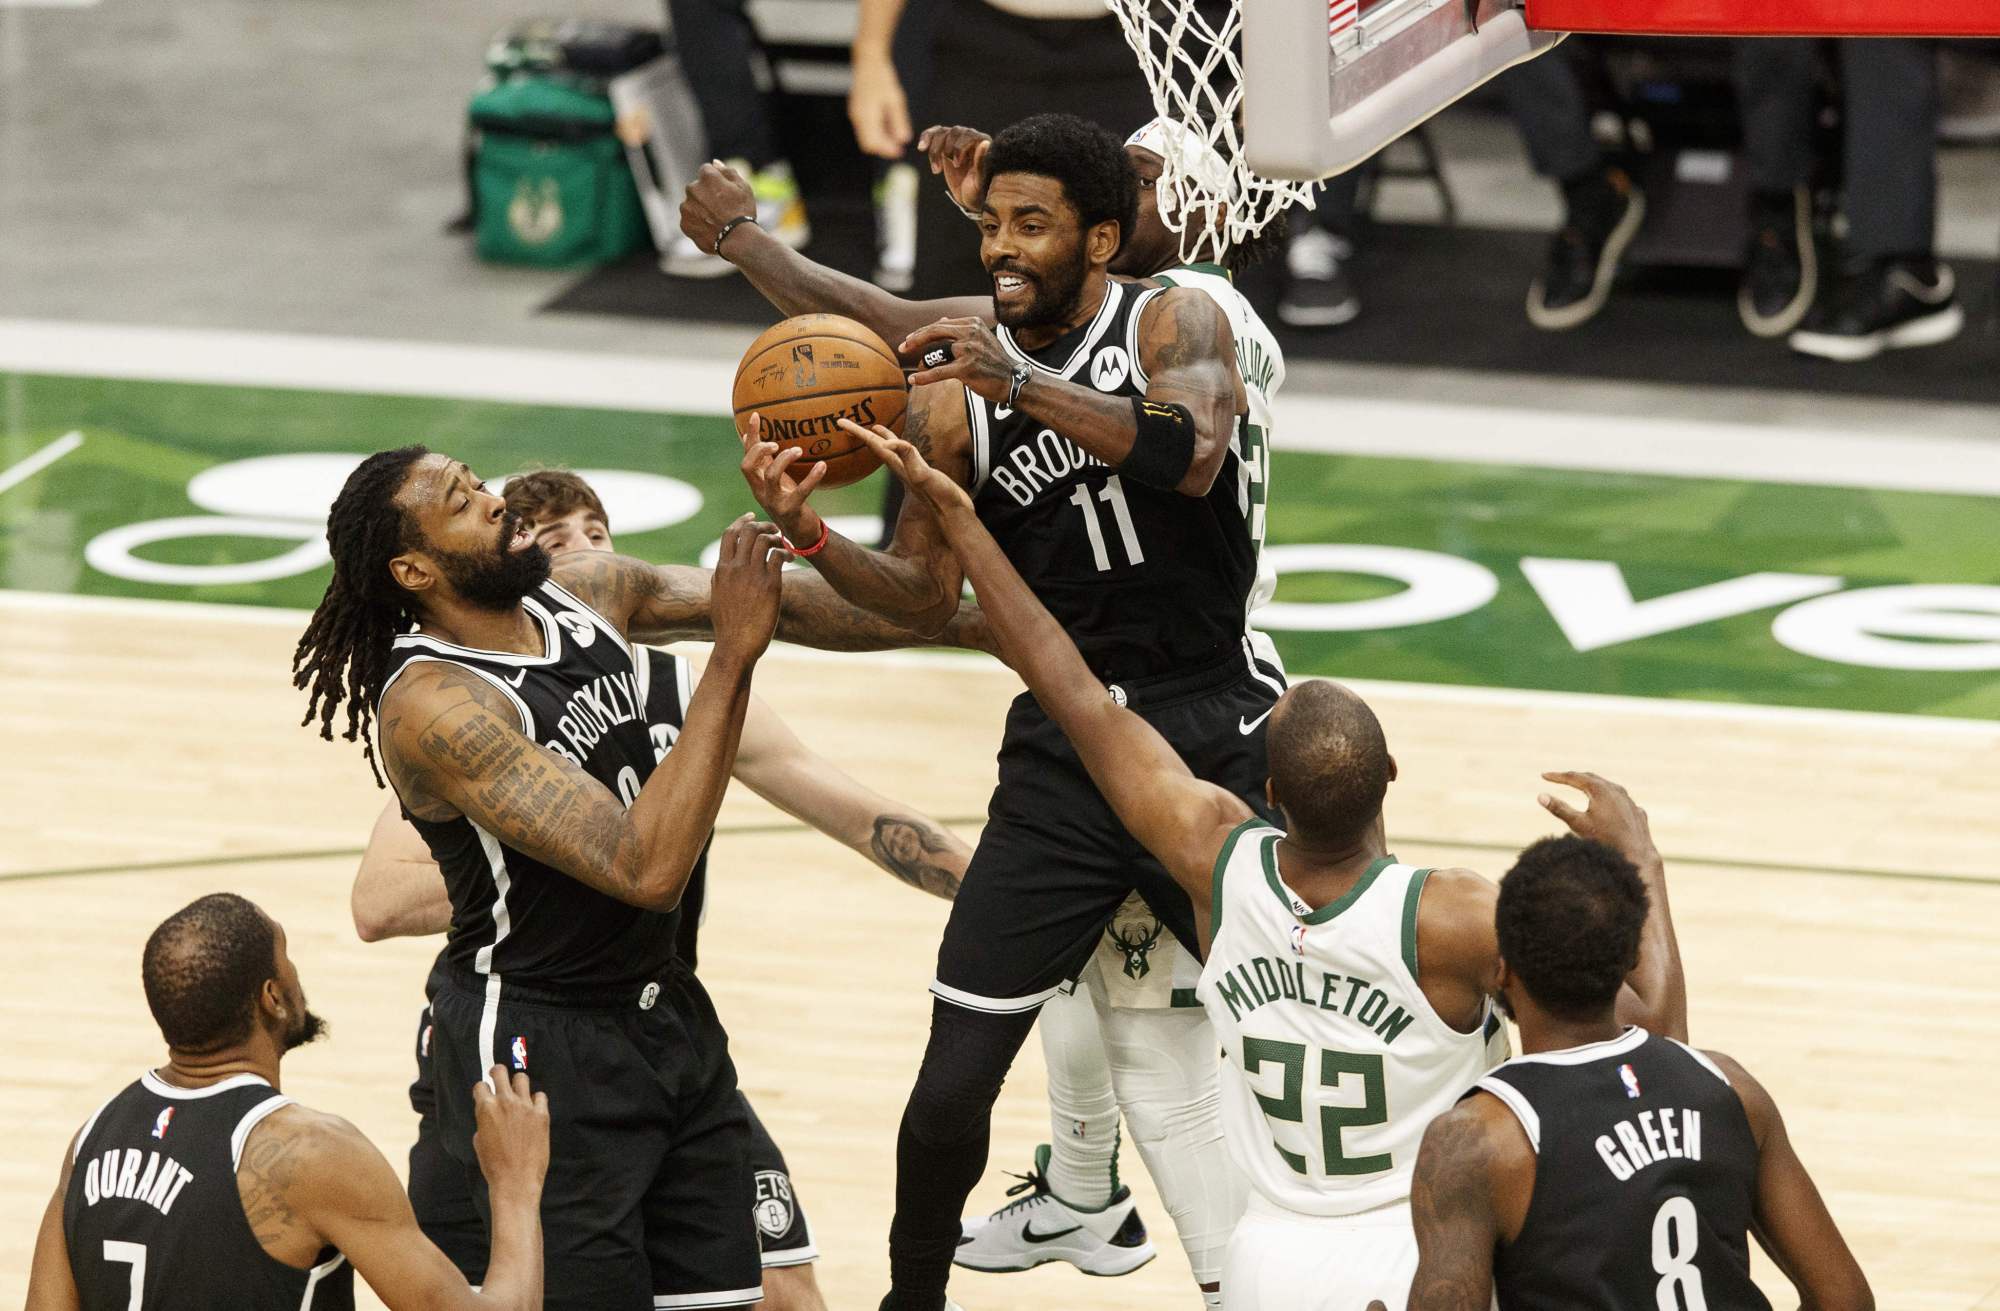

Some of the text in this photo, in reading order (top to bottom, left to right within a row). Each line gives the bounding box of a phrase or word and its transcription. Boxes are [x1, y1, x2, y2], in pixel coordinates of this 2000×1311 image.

[759, 396, 877, 442] SPALDING
[1069, 474, 1145, 572] 11
[1216, 957, 1415, 1046] MIDDLETON
[1243, 1036, 1393, 1176] 22
[1595, 1107, 1701, 1181] GREEN
[84, 1148, 194, 1216] DURANT
[754, 1173, 792, 1201] ETS
[103, 1239, 147, 1311] 7
[1651, 1195, 1708, 1311] 8
